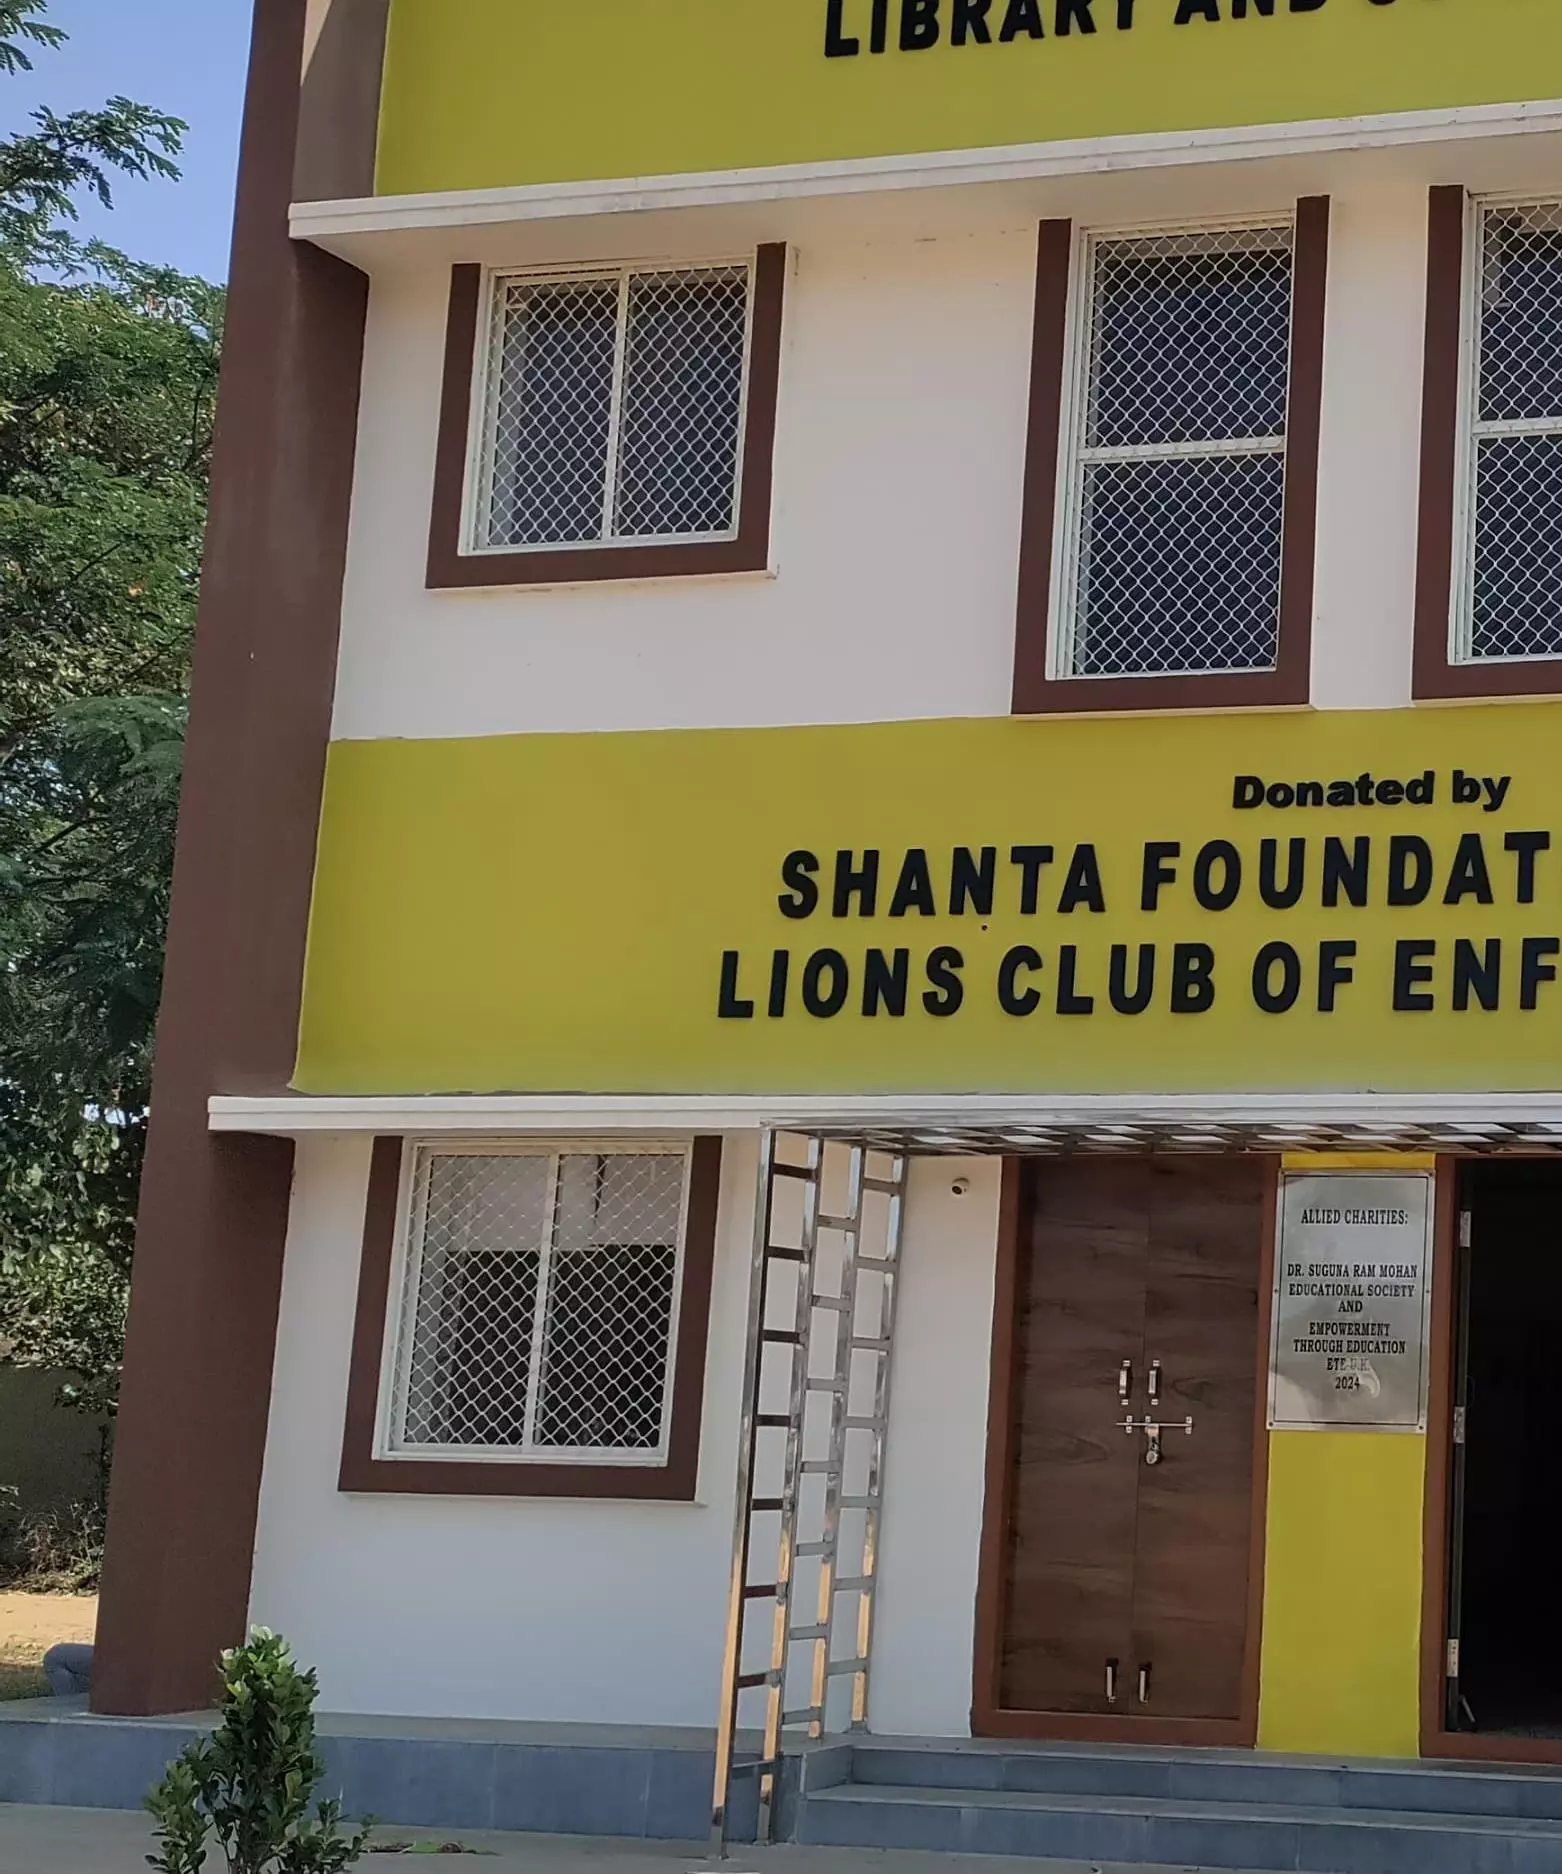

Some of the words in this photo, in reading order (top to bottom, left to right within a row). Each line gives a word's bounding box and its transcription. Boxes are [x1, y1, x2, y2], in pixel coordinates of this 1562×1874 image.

[1232, 770, 1436, 810] Donated
[1452, 769, 1512, 813] by
[777, 843, 1106, 920] SHANTA
[717, 945, 965, 1019] LIONS
[997, 942, 1215, 1017] CLUB
[1251, 939, 1357, 1015] OF
[1301, 1209, 1340, 1224] ALLIED
[1344, 1209, 1408, 1225] CHARITIES:
[1287, 1263, 1304, 1277] DR.
[1308, 1264, 1349, 1277] SUGUNA
[1353, 1264, 1375, 1277] RAM
[1379, 1265, 1417, 1278] MOHAN
[1289, 1283, 1364, 1297] EDUCATIONAL
[1367, 1285, 1415, 1297] SOCIETY
[1338, 1300, 1363, 1313] AND
[1309, 1322, 1390, 1336] EMPOWERMENT
[1293, 1339, 1343, 1353] THROUGH
[1346, 1340, 1406, 1354] EDUCATION
[1335, 1376, 1360, 1391] 2024
